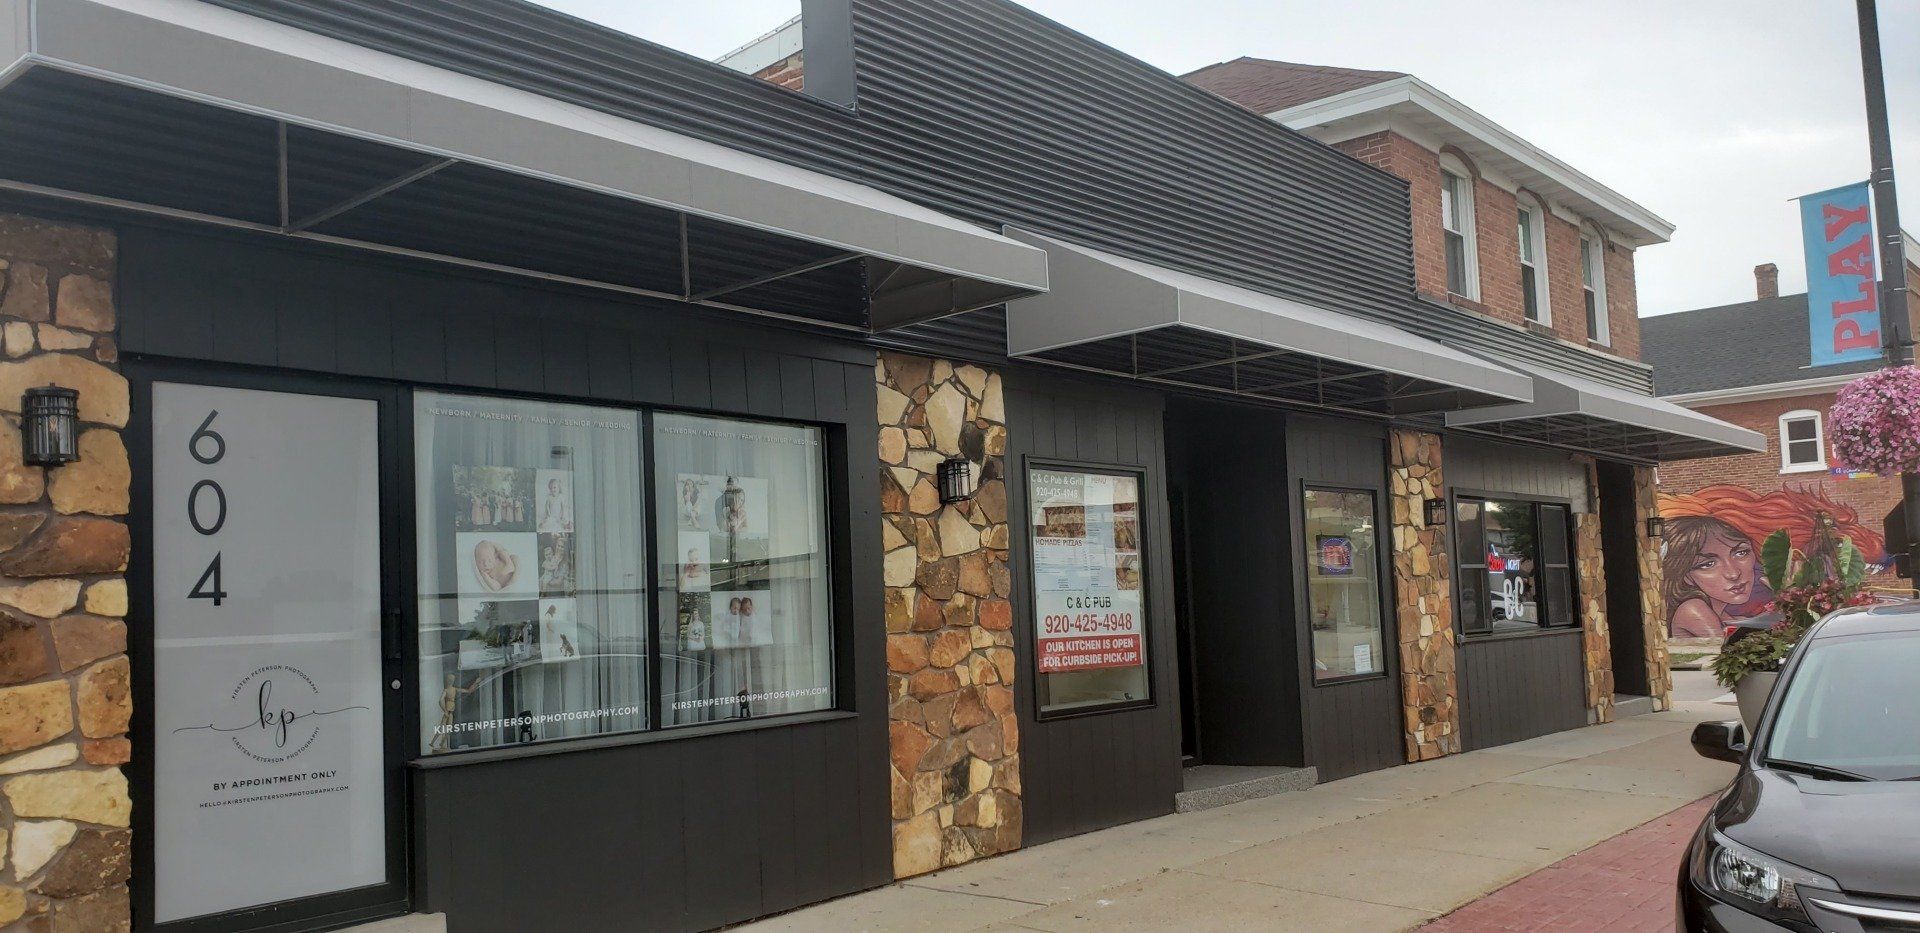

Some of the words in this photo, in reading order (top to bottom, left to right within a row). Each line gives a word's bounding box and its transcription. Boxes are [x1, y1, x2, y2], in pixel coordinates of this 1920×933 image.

[1822, 203, 1880, 354] PLAY
[430, 407, 472, 417] NEWBORN
[479, 410, 523, 422] MATERNITY
[531, 416, 556, 425] FAMILY
[598, 420, 630, 430] WEDDING
[1031, 473, 1036, 483] C
[1037, 474, 1042, 483] &
[1043, 474, 1049, 483] C
[1050, 475, 1061, 485] Pub
[1063, 476, 1069, 485] &
[187, 409, 227, 606] 604
[1062, 539, 1082, 547] PIZZAS
[1066, 597, 1074, 608] C
[1075, 597, 1083, 608] &
[1084, 597, 1091, 608] C
[1093, 597, 1112, 608] PUB
[1045, 613, 1132, 634] 920-425-4948
[1045, 641, 1064, 653] OUR
[1066, 639, 1101, 651] KITCHEN
[1102, 639, 1110, 649] IS
[1112, 638, 1134, 648] OPEN
[1043, 656, 1062, 668] FOR
[1062, 654, 1102, 667] CURBSIDE
[1103, 651, 1137, 663] PICK-UP!
[232, 676, 251, 700] KIRSTEN
[251, 665, 282, 677] PETERSON
[285, 665, 319, 694] PHOTOGRAPHY
[671, 687, 829, 710] KIRSTENPETERSONPHOTOGRAPHY.COM
[434, 705, 640, 735] KIRSTENPETERSONPHOTOGRAPHY.COM
[232, 736, 251, 757] KIRSTEN
[252, 754, 285, 763] PETERSON
[286, 726, 320, 760] PHOTOGRAPHY
[213, 782, 227, 791] BY
[231, 773, 308, 789] APPOINTMENT
[311, 770, 337, 780] ONLY
[199, 785, 350, 809] HELLO@KIRSTENPETERSONPHOTOGRAPHY.COM
